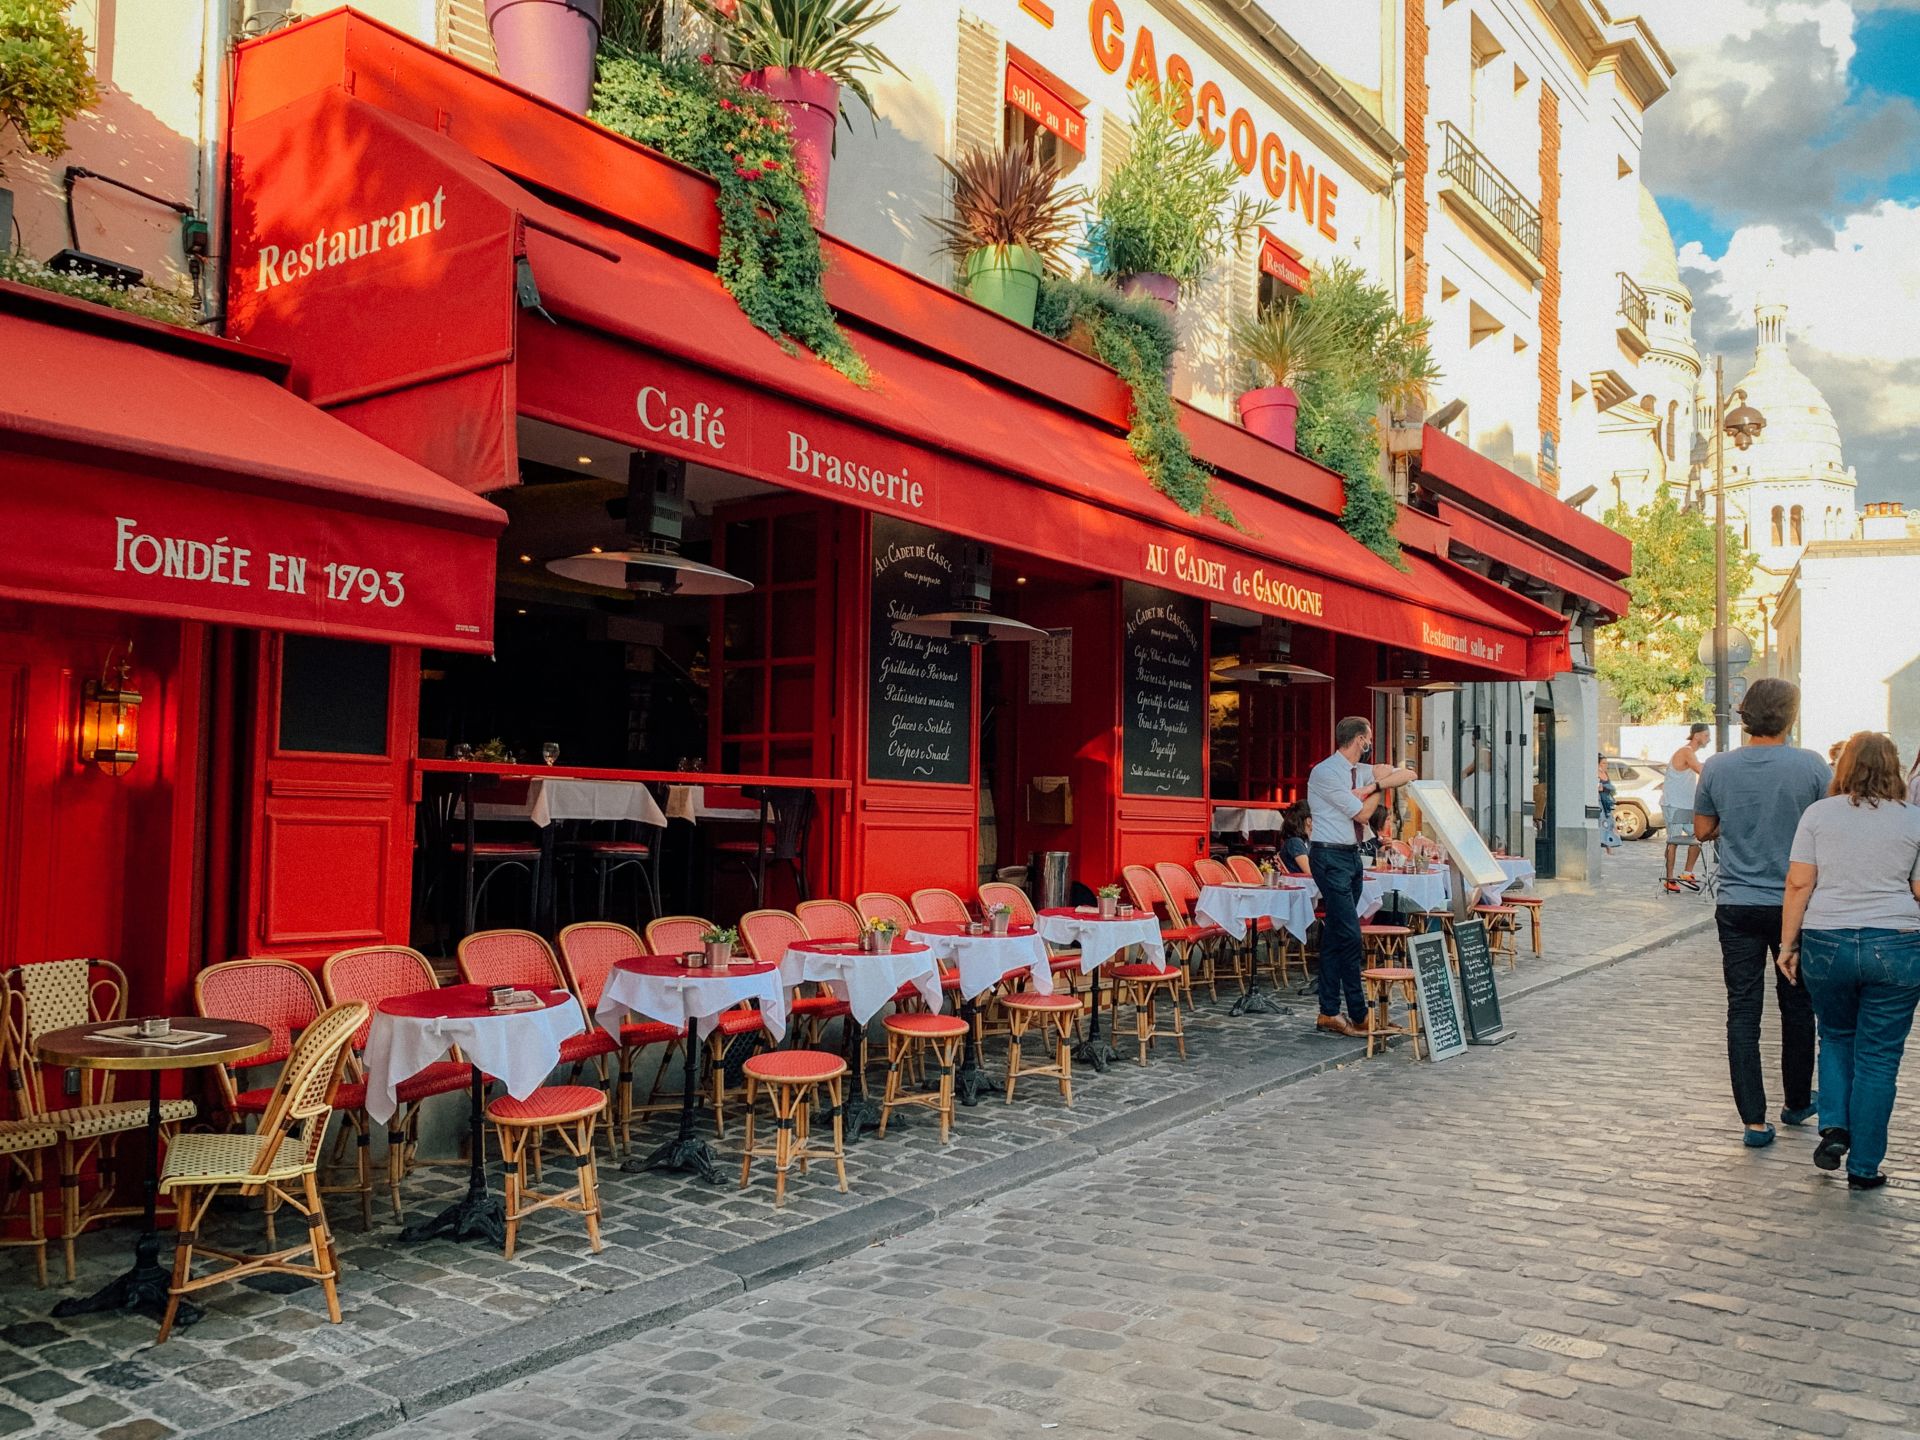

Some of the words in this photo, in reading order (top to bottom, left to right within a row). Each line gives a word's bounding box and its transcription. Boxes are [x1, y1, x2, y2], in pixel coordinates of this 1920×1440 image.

[1012, 85, 1042, 117] salle
[1046, 111, 1059, 131] au
[1064, 117, 1080, 139] 1er
[1088, 0, 1338, 243] GASCOGNE
[255, 184, 447, 293] Restaurant
[1266, 251, 1308, 290] Restaura
[636, 385, 726, 450] Café
[786, 430, 924, 509] Brasserie
[113, 516, 251, 587] FONDÉE
[267, 552, 307, 595] EN
[323, 562, 405, 608] 1793
[874, 555, 890, 577] AU
[887, 542, 915, 564] CADET
[915, 545, 926, 558] DE
[904, 570, 919, 581] vous
[917, 575, 942, 588] propose
[1145, 543, 1169, 575] AU
[1174, 544, 1227, 591] CADET
[1232, 570, 1251, 597] de
[1252, 568, 1323, 617] GASCOGNE
[888, 629, 914, 649] Plats
[914, 638, 924, 651] du
[1422, 621, 1468, 654] Restaurant
[1470, 636, 1486, 659] salle
[1486, 647, 1494, 661] au
[879, 656, 920, 683] Grillades
[926, 663, 959, 682] Poissons
[1168, 652, 1191, 668] Chocolat
[1168, 679, 1192, 692] pression
[928, 695, 955, 710] maison
[1167, 697, 1190, 713] Cocktails
[888, 714, 917, 738] Glaces
[924, 717, 952, 735] Sorbets
[1137, 712, 1152, 729] Vins
[888, 740, 919, 767] Crêpes
[925, 743, 950, 761] Snack
[1150, 737, 1177, 763] Digestifs
